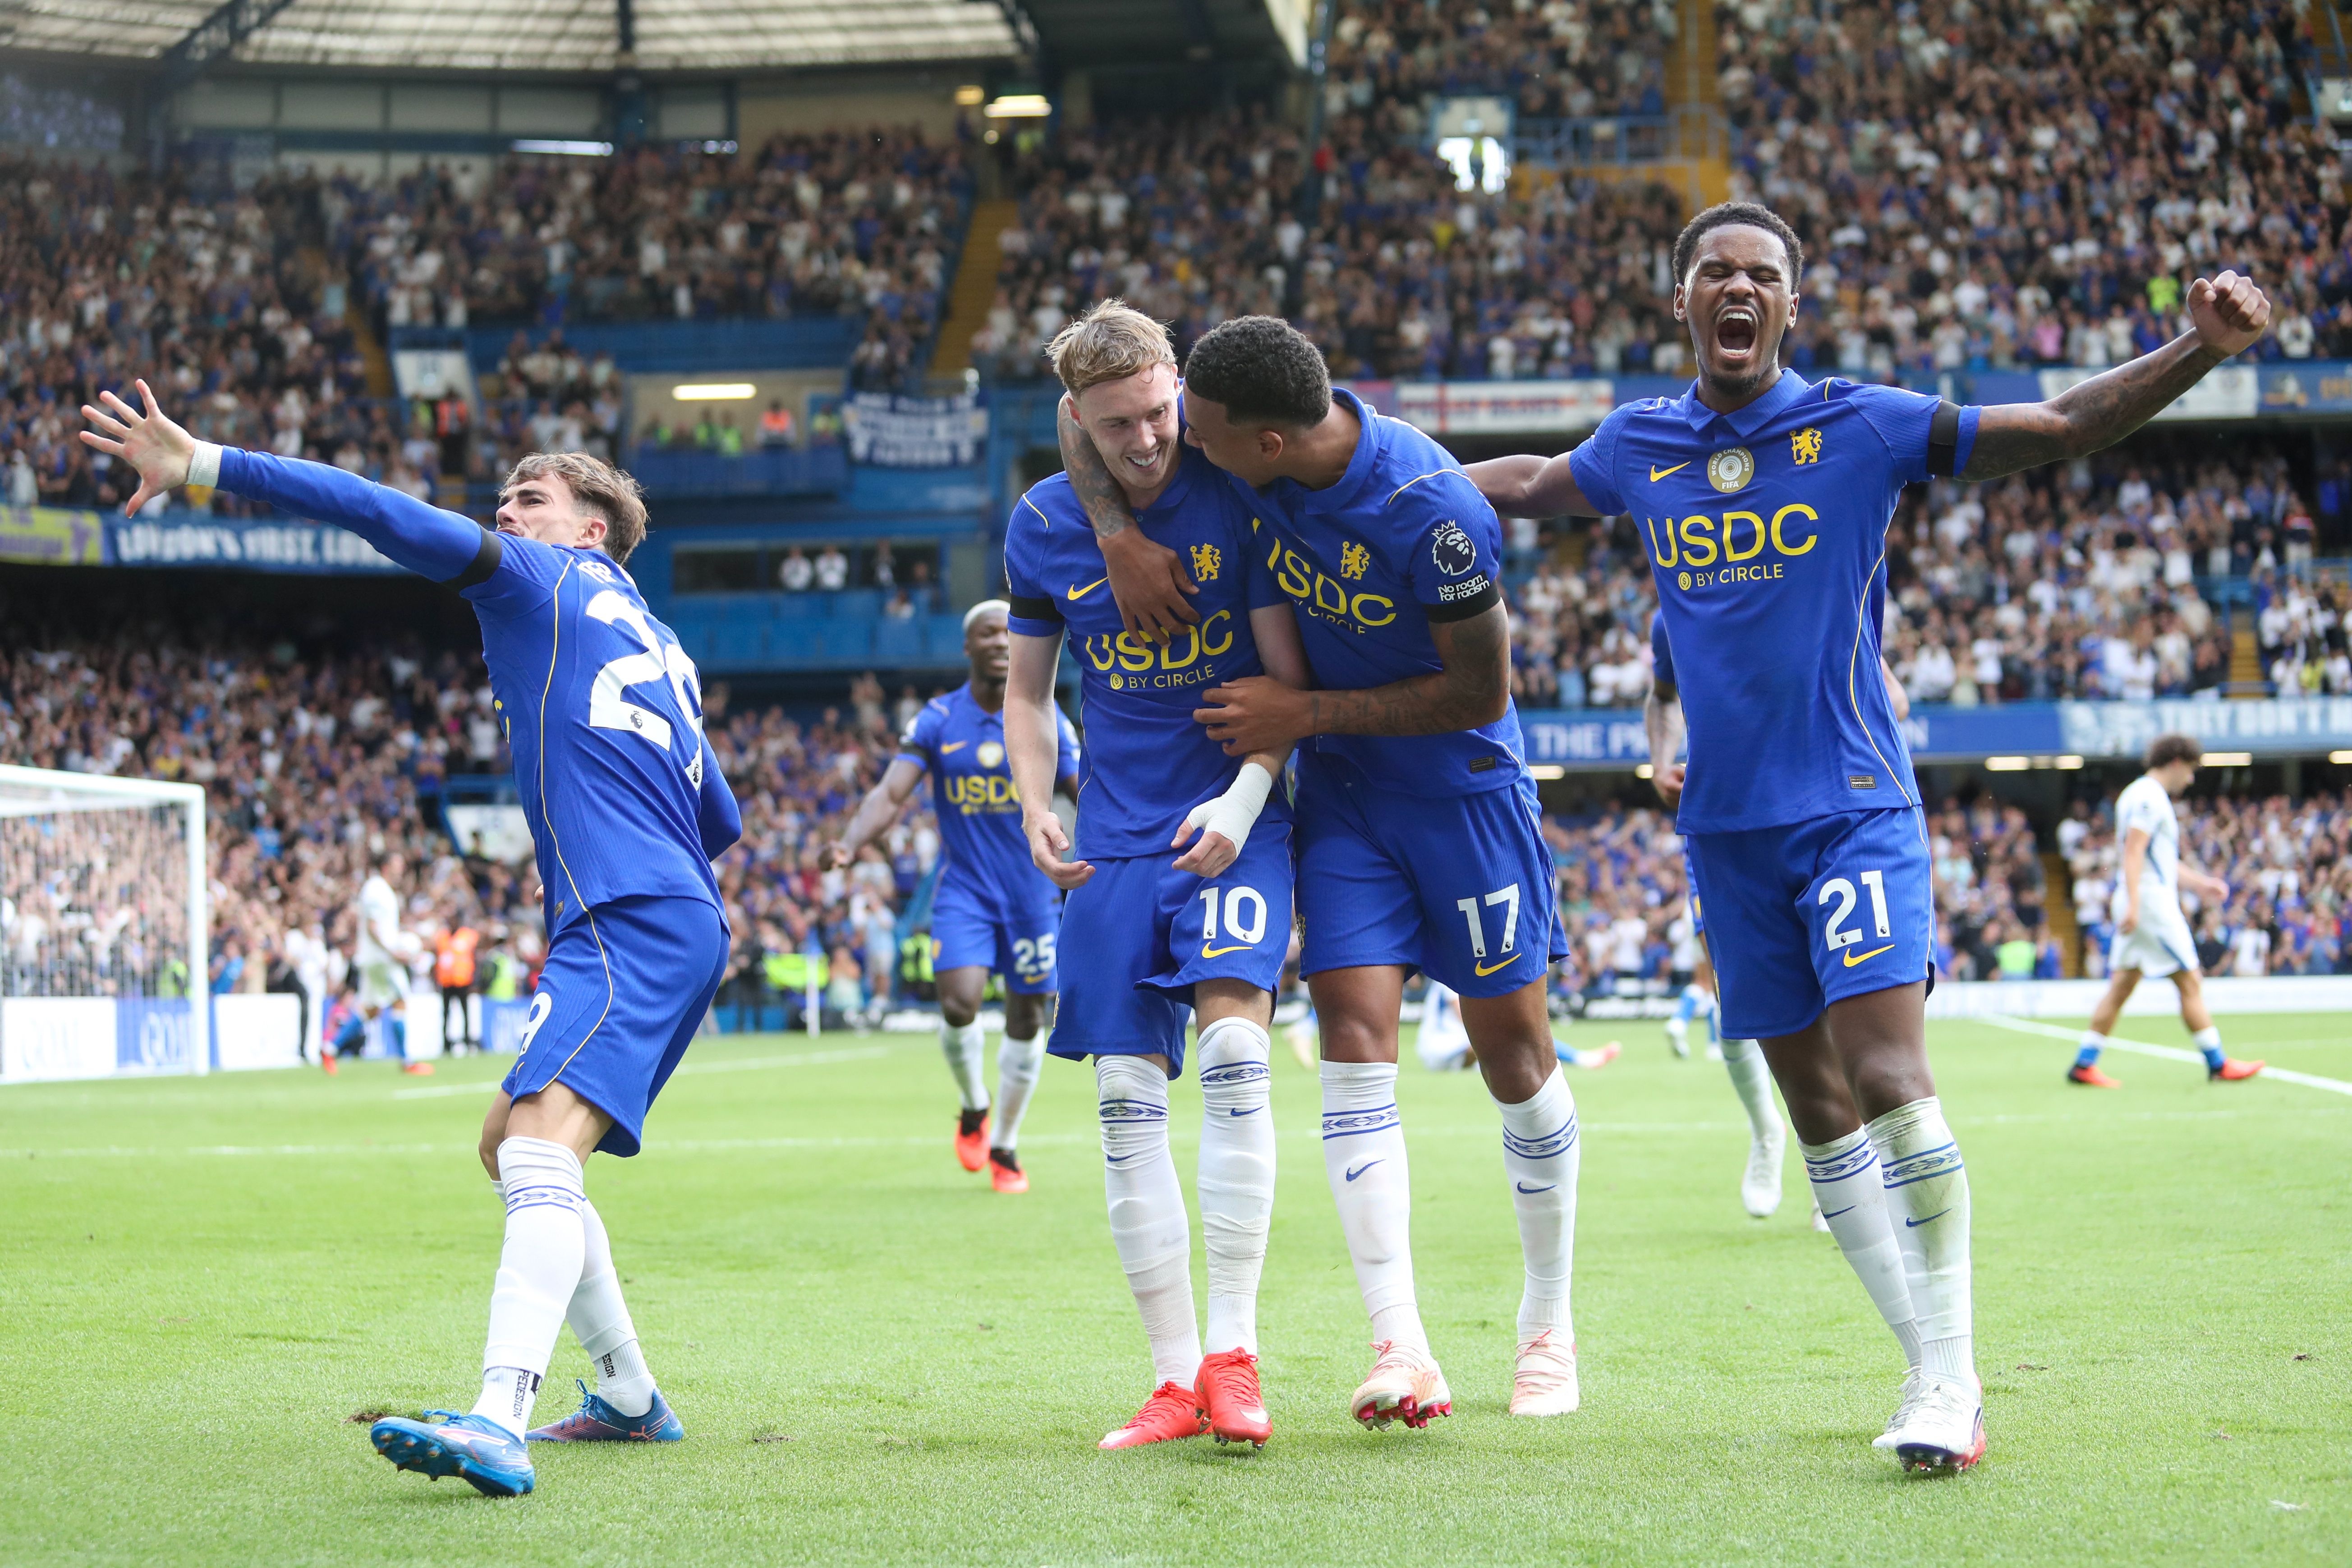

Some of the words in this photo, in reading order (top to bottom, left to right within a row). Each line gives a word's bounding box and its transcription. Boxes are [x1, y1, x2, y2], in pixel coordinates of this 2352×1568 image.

[1712, 453, 1722, 476] WORLD
[1723, 448, 1750, 471] CHAMPIONS
[1722, 481, 1739, 489] FIFA
[1647, 503, 1819, 568] USDC
[1438, 584, 1455, 593] No
[1456, 575, 1483, 592] room
[1440, 592, 1456, 601] for
[1457, 580, 1490, 599] racism
[1696, 572, 1714, 587] BY
[1719, 564, 1783, 583] CIRCLE
[1085, 609, 1233, 671] USDC
[1129, 676, 1148, 689] BY
[1154, 664, 1215, 688] CIRCLE
[1530, 722, 1606, 759] THE
[1199, 886, 1267, 944] 10
[1457, 883, 1520, 957] 17
[1818, 870, 1891, 951] 21
[1012, 932, 1055, 974] 25
